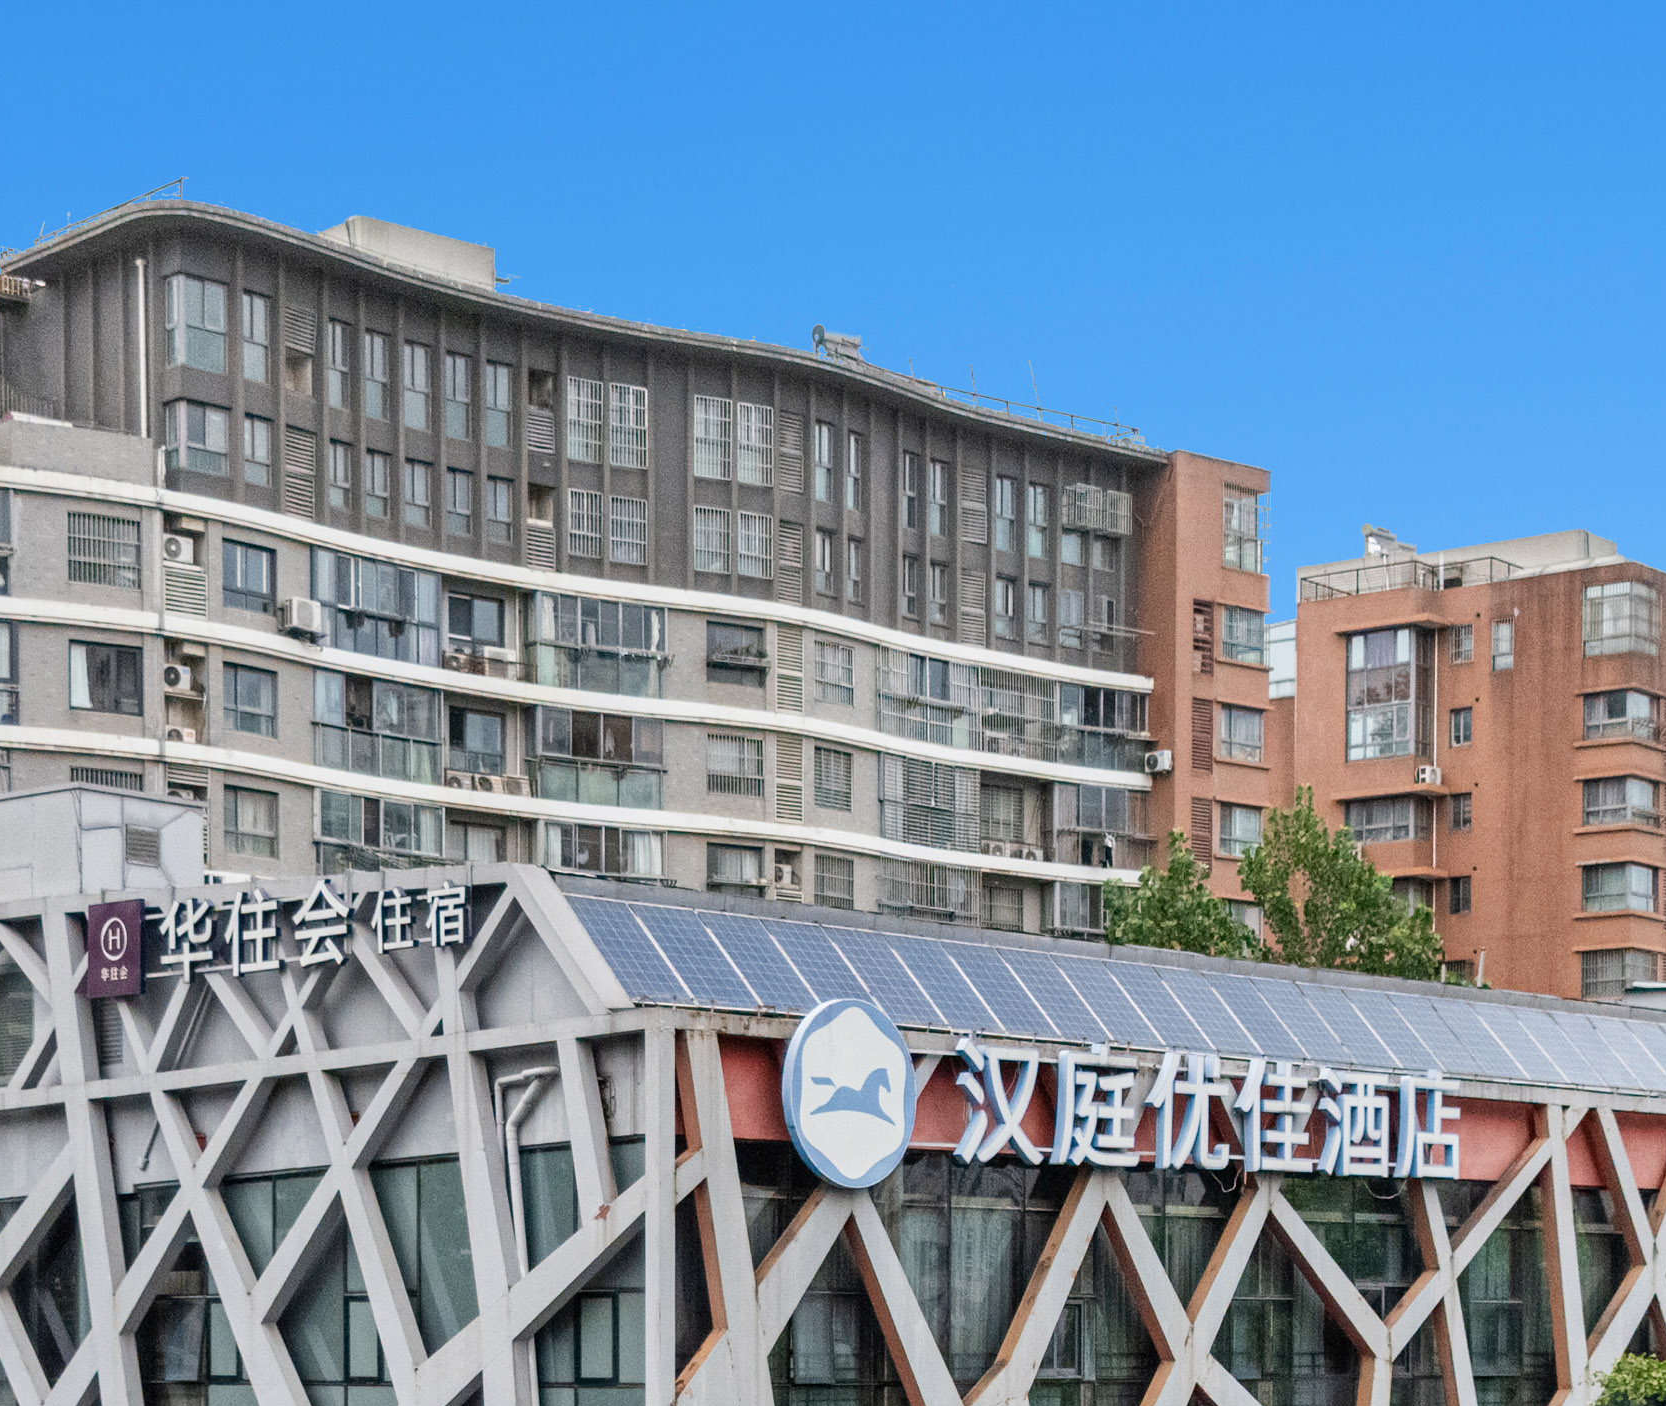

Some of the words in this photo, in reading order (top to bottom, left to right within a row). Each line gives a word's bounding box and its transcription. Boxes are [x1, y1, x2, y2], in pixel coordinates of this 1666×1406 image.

[953, 1036, 1461, 1180] 汉庭优佳酒店
